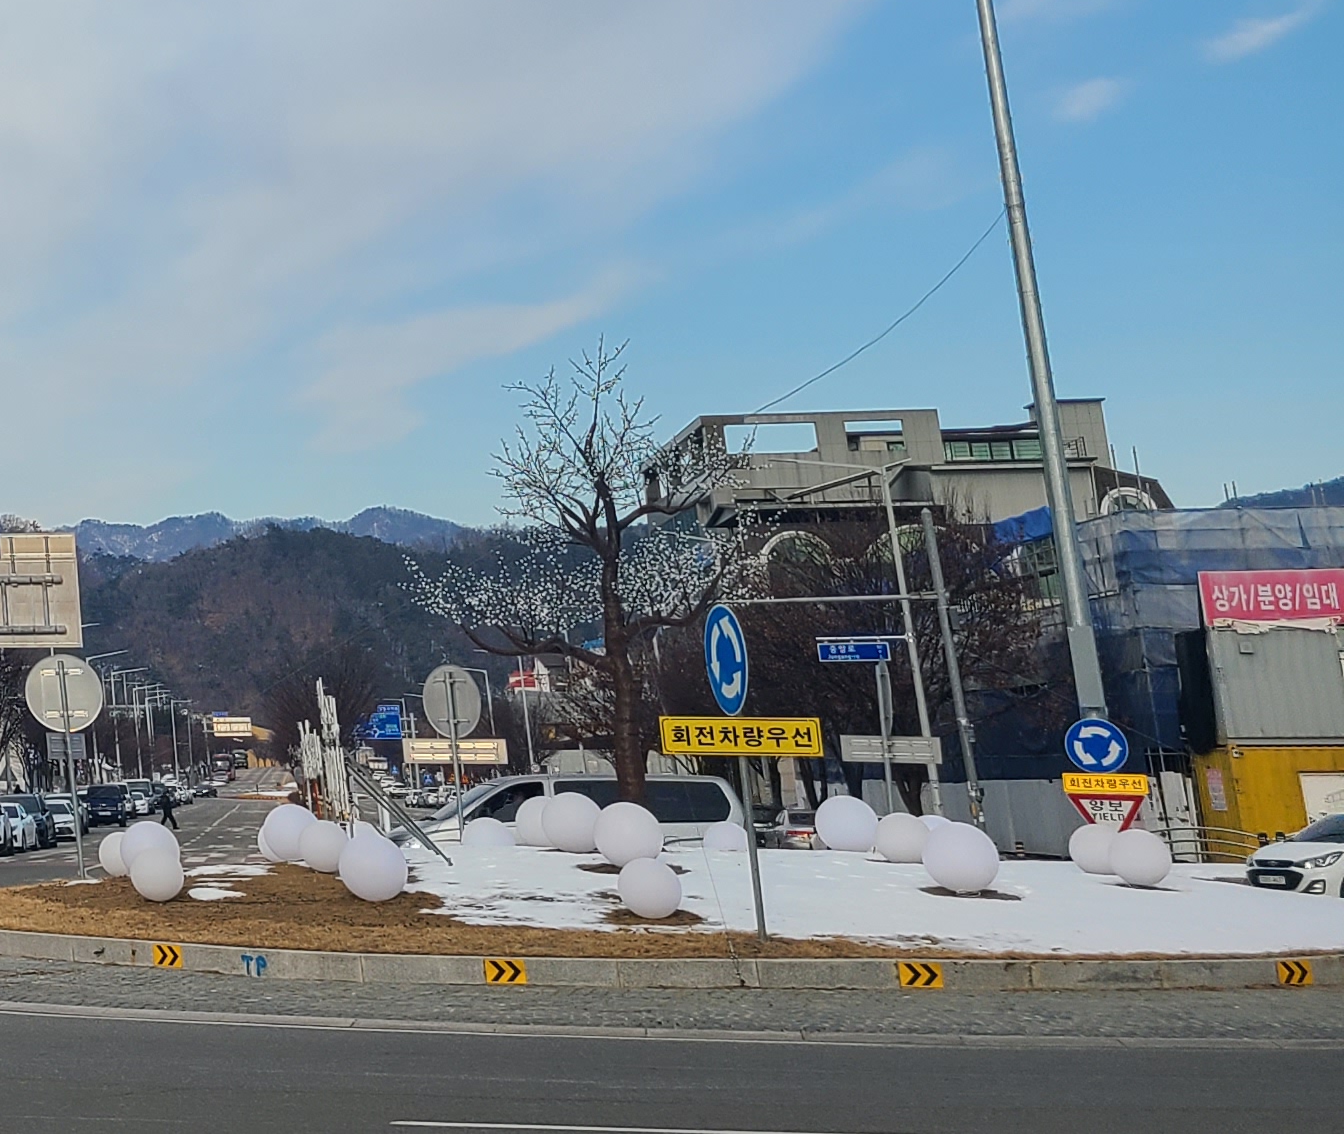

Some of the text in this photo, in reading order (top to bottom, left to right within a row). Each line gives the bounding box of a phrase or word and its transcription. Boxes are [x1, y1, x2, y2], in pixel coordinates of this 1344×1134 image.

[1212, 582, 1341, 612] 상가/분양/임대
[670, 725, 815, 749] 회전차량우선
[1069, 777, 1143, 790] 회전차량우선
[1089, 799, 1124, 812] 양보
[1091, 812, 1126, 822] YIELD
[240, 953, 268, 978] TP
